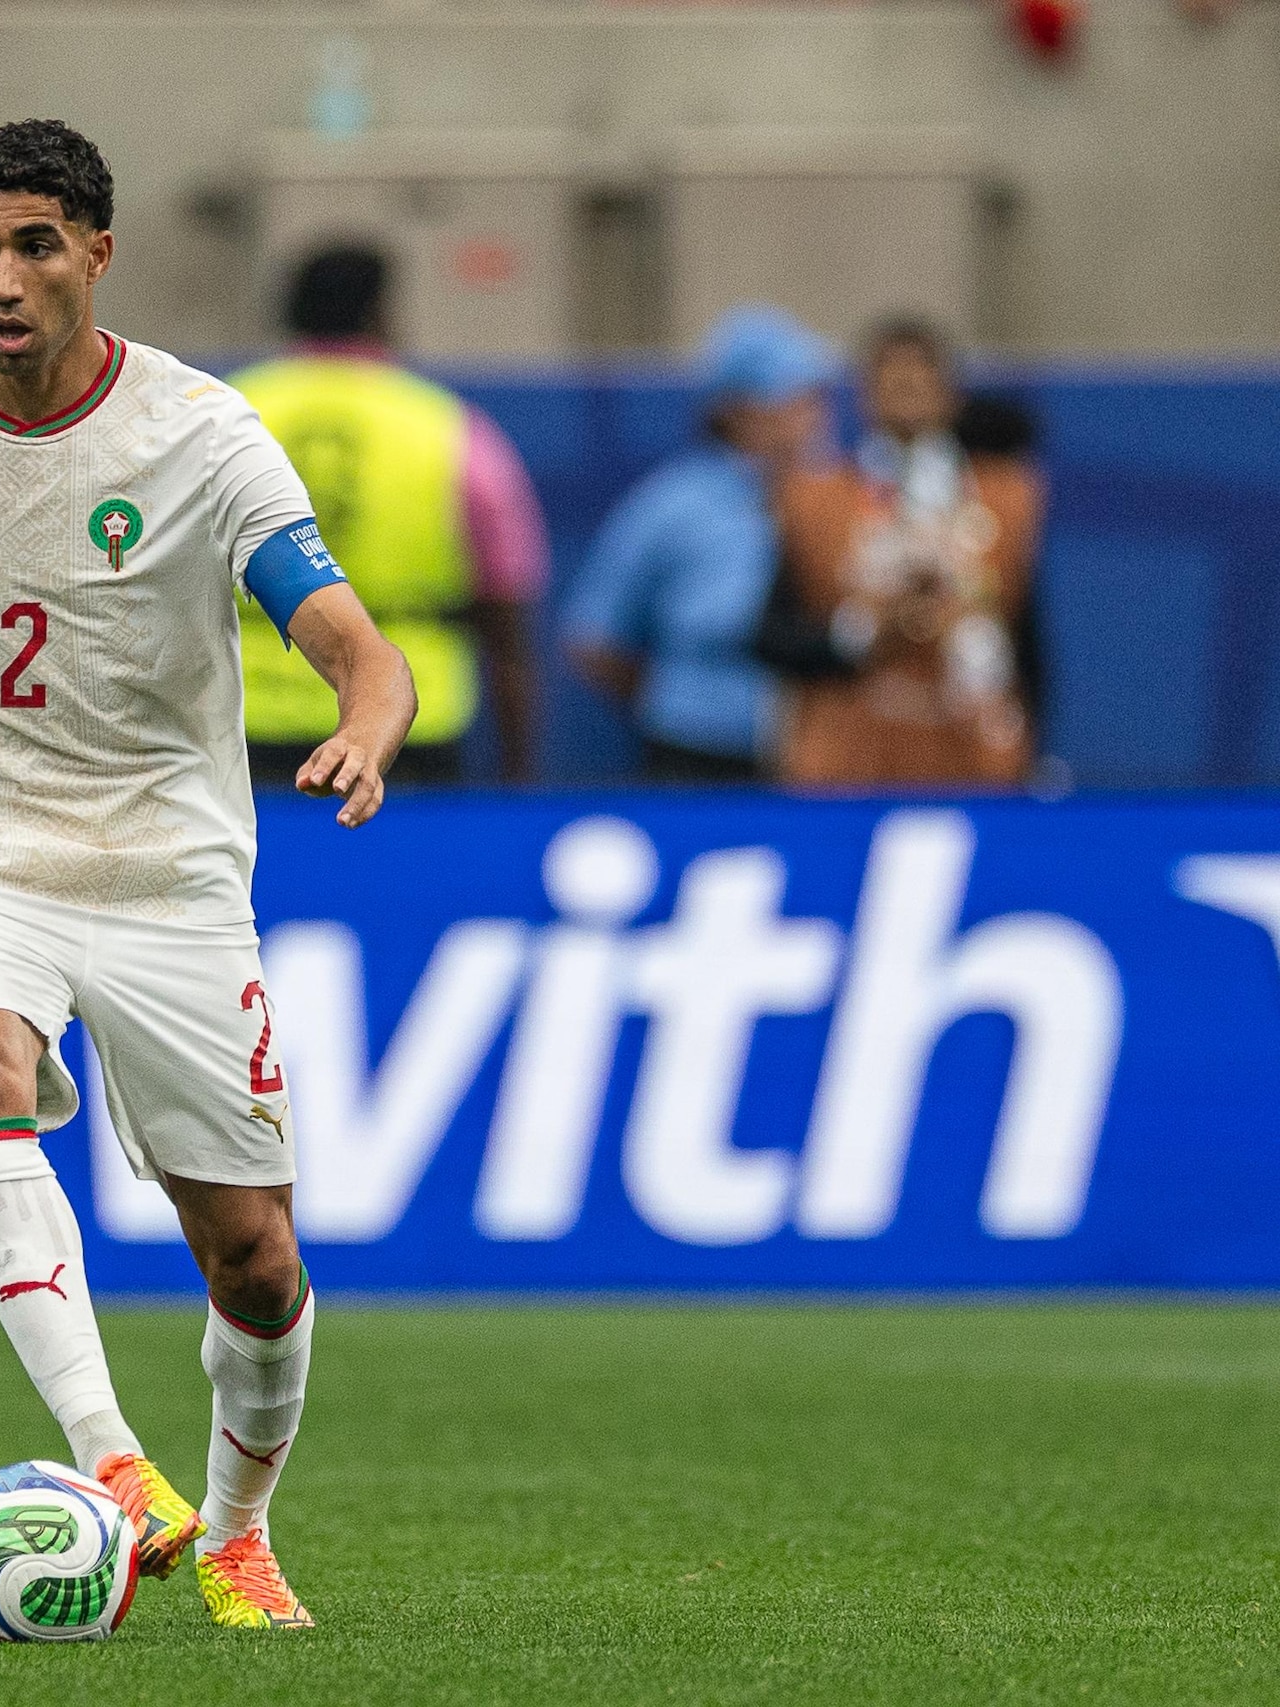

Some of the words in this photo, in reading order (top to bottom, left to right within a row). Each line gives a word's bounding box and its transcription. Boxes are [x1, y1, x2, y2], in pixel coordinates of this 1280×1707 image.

[0, 602, 48, 709] 2
[80, 804, 1123, 1246] with
[241, 980, 284, 1095] 2
